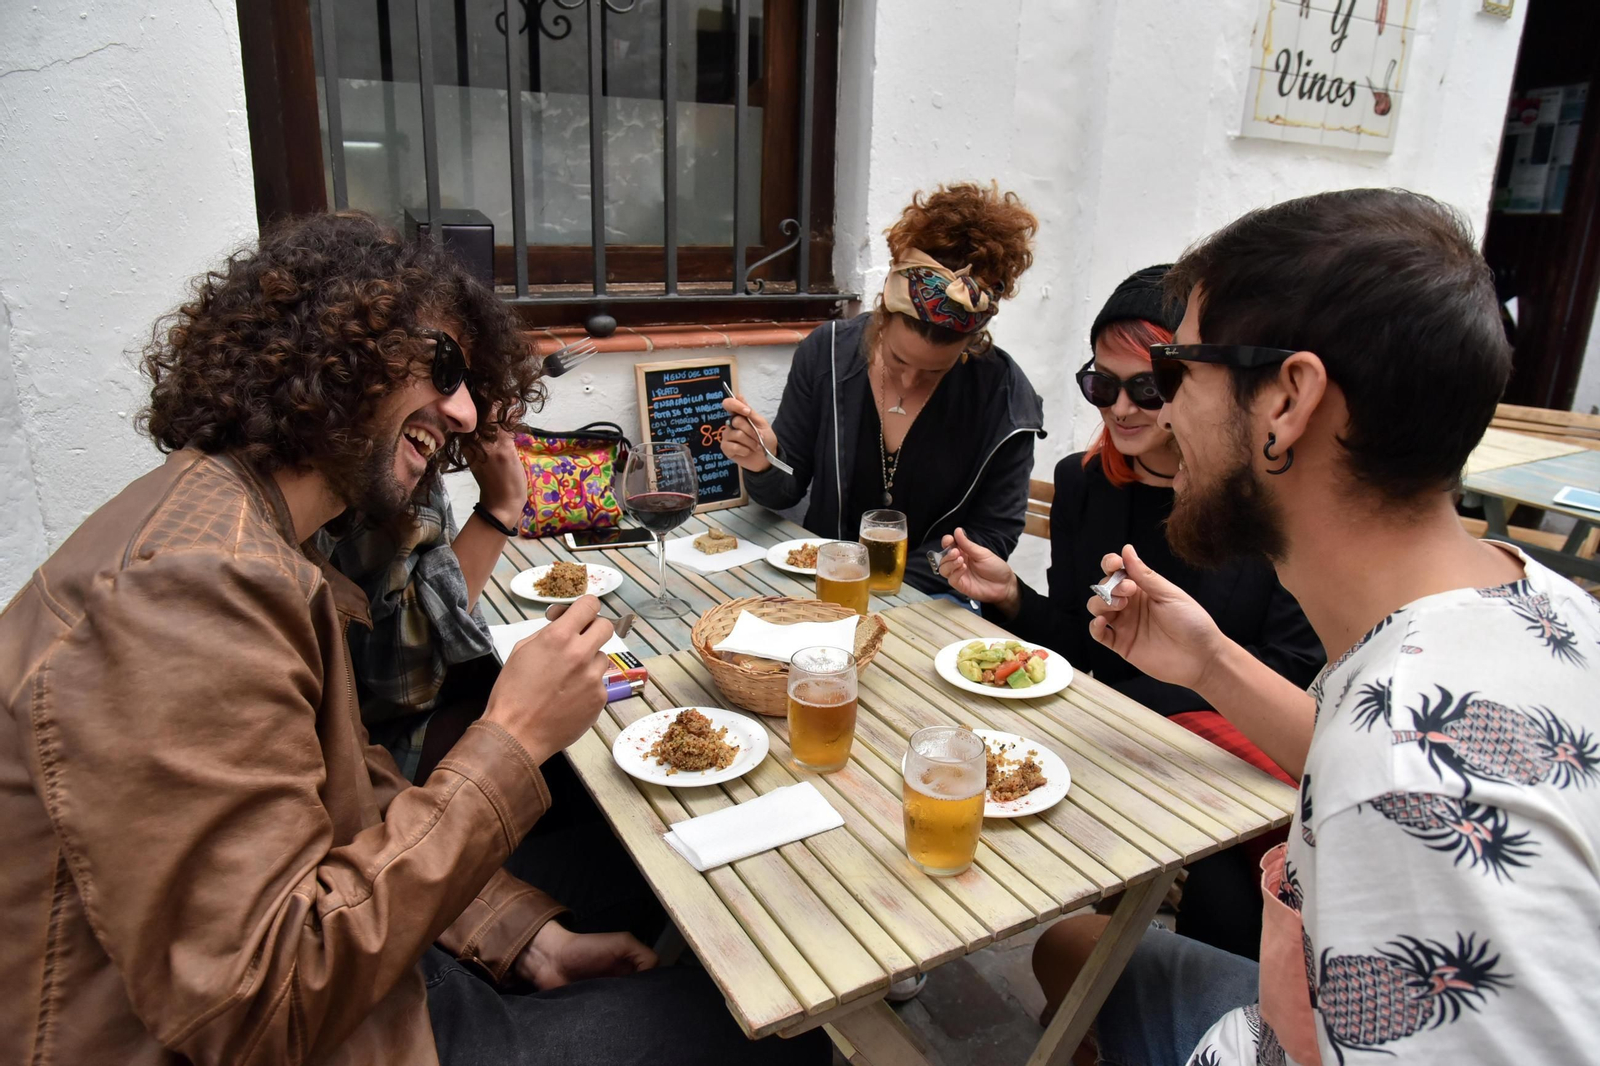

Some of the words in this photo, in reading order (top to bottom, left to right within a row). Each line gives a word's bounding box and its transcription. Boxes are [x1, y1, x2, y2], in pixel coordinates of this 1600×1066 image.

[1274, 48, 1357, 108] Vinos
[651, 420, 667, 429] CON
[698, 450, 724, 462] FRITO
[698, 484, 723, 496] OSTRE
